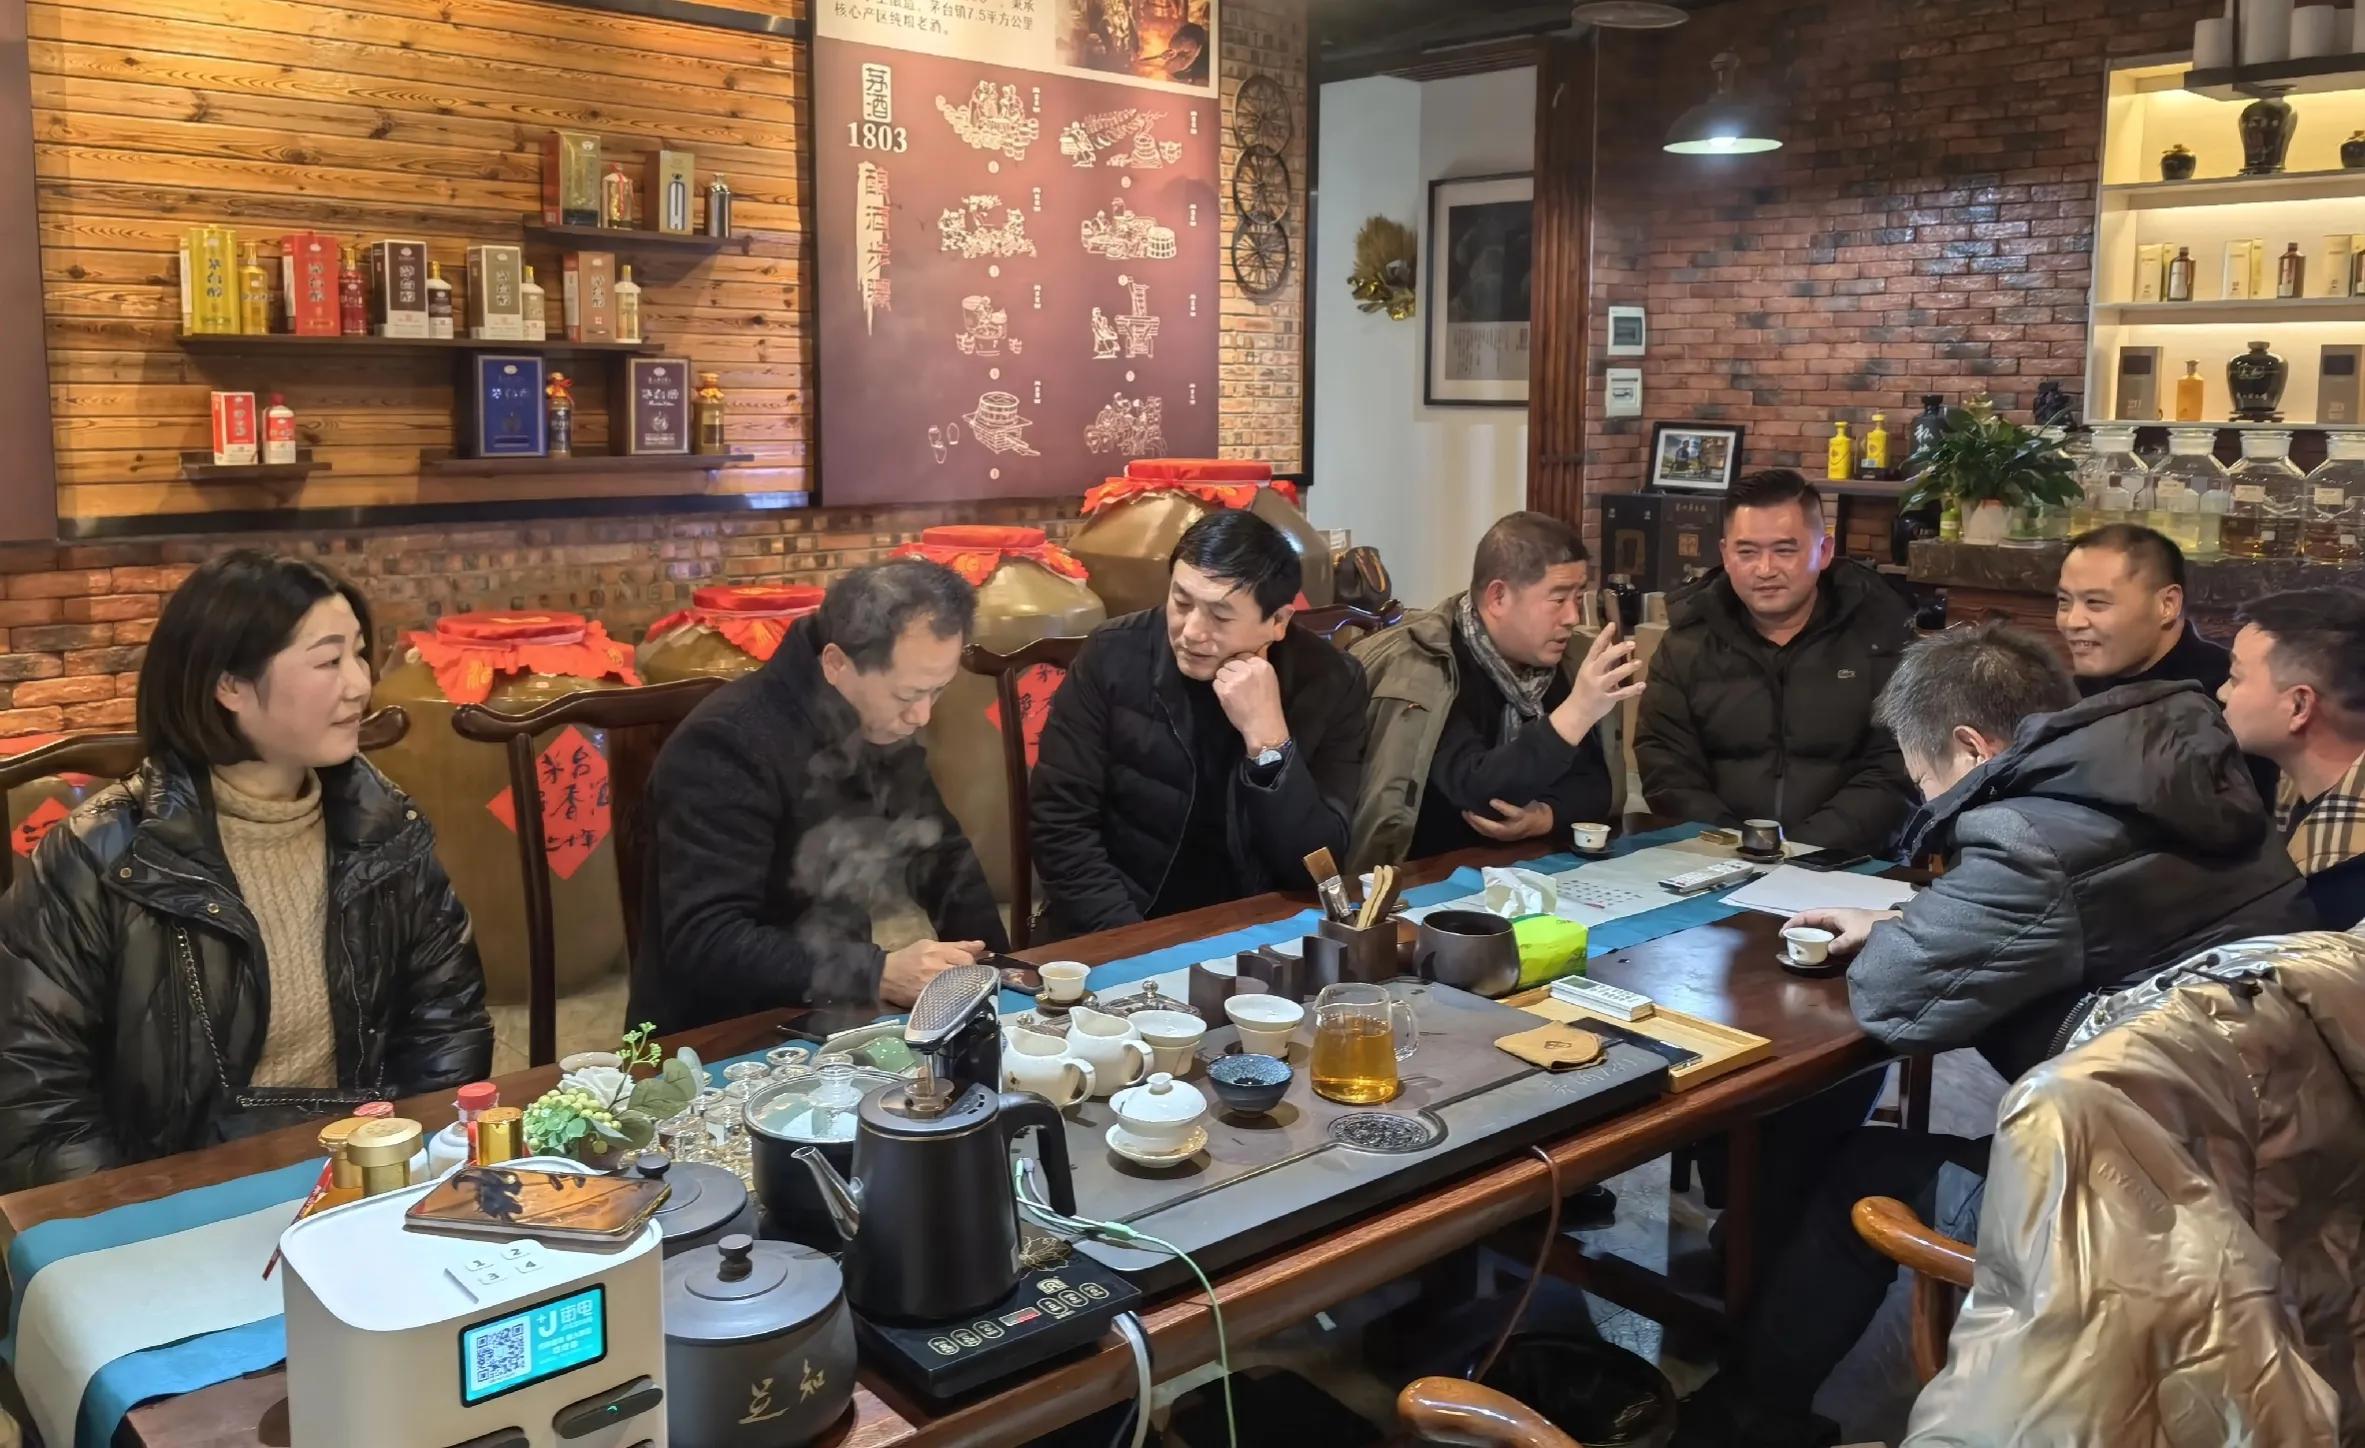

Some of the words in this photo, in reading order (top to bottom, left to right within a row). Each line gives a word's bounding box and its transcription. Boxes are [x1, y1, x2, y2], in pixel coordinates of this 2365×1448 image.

[848, 121, 908, 153] 1803
[510, 1248, 522, 1256] 2
[487, 1272, 501, 1281] 3
